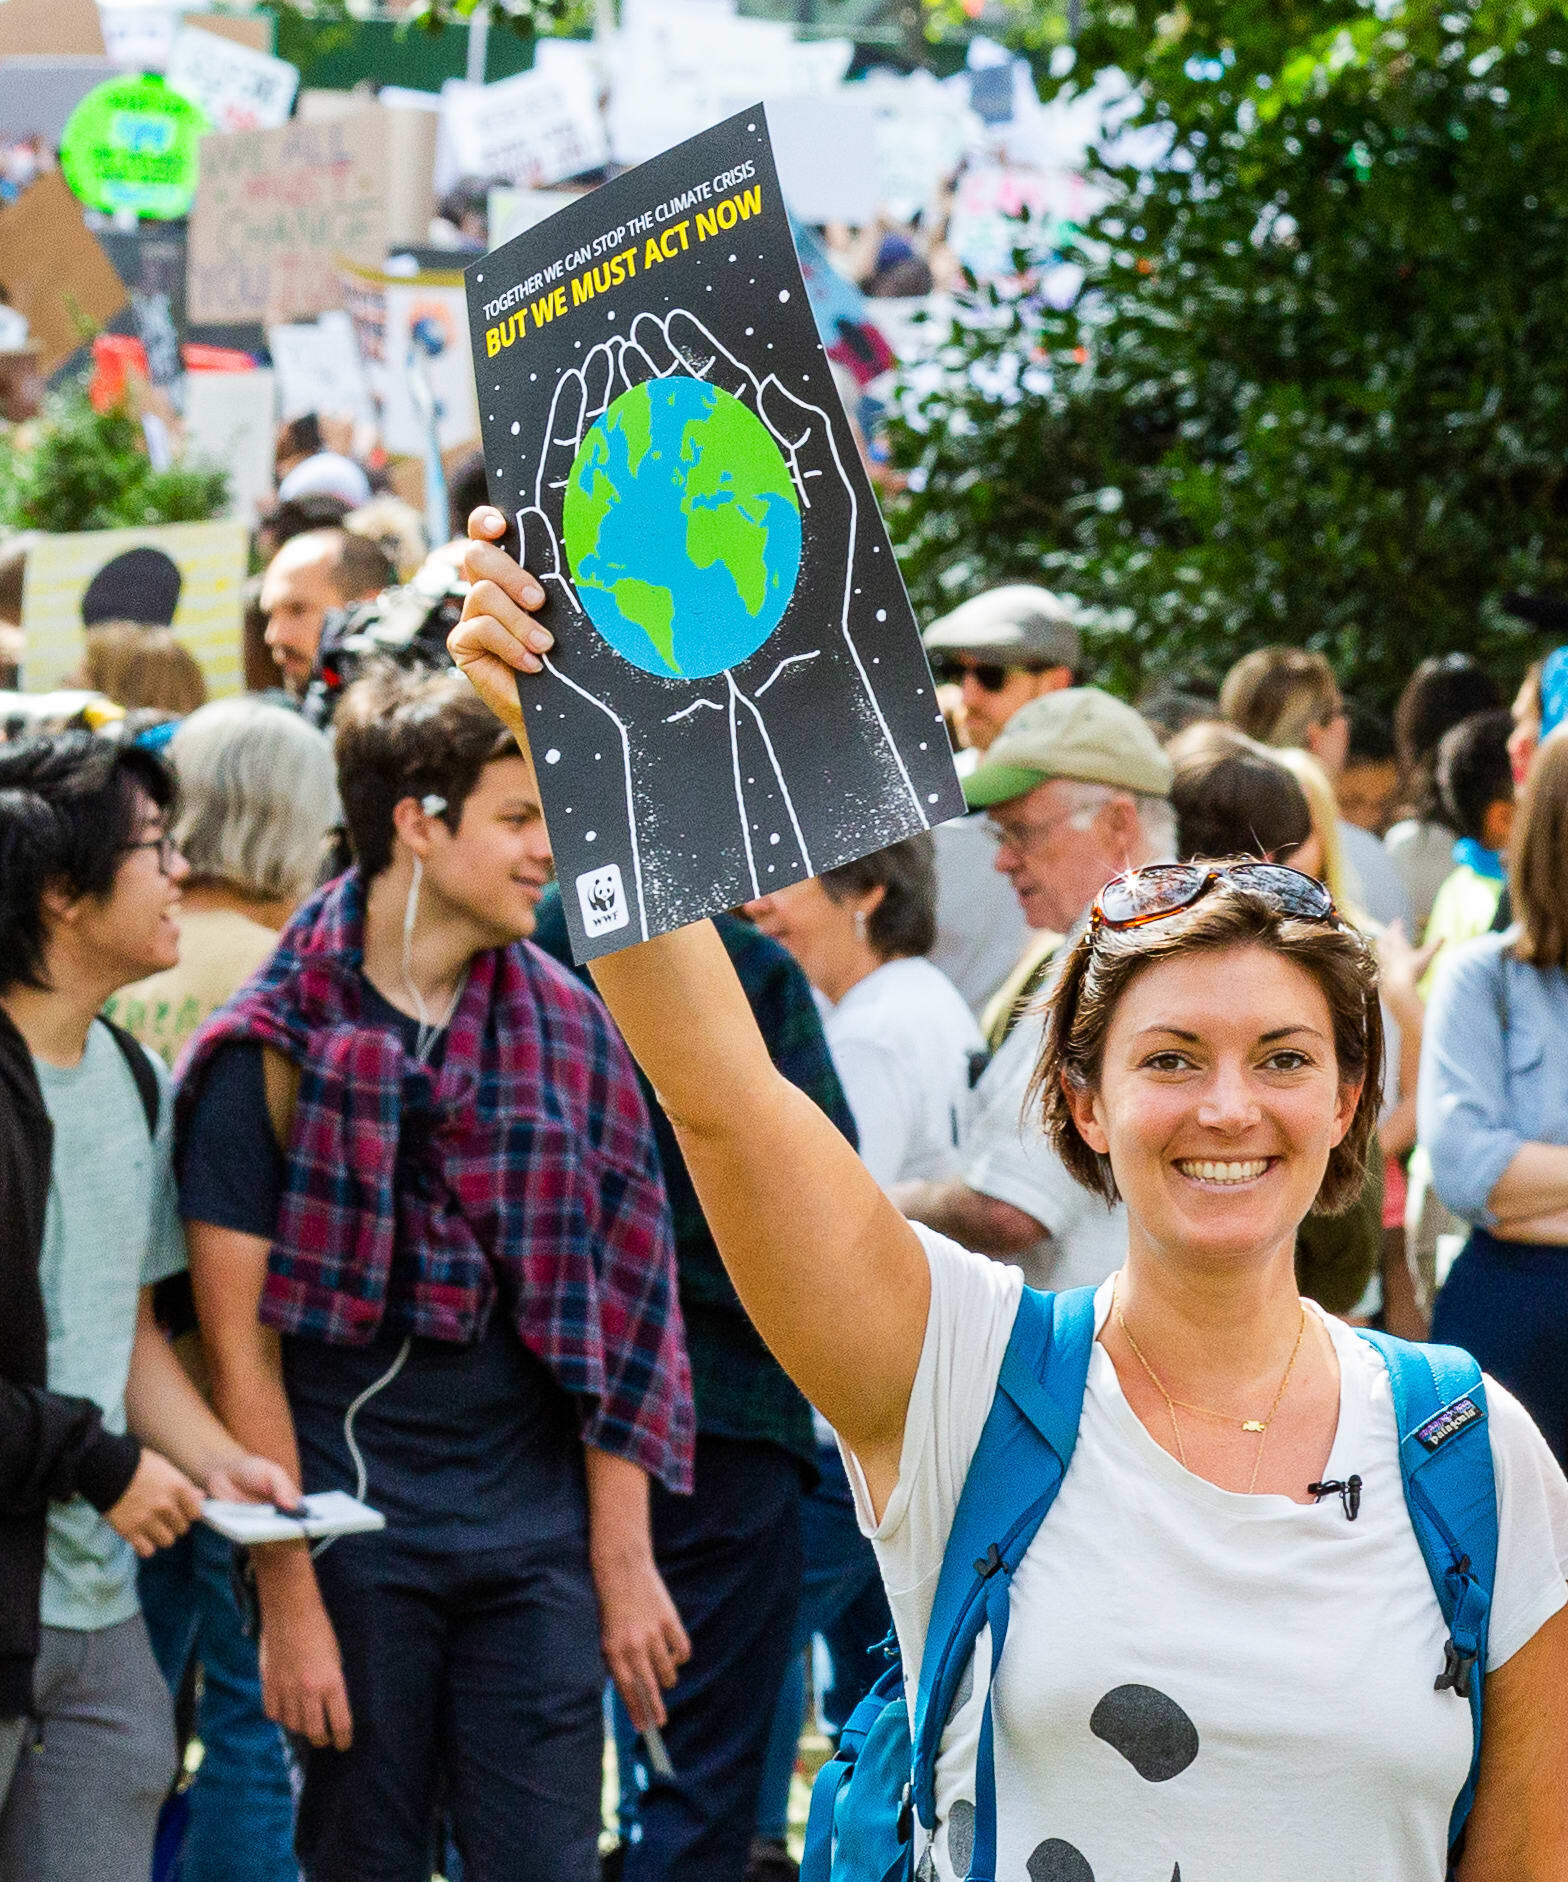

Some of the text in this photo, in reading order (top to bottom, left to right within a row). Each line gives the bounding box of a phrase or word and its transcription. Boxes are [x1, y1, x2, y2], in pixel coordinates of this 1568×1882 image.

[483, 160, 756, 320] TOGETHER WE CAN STOP THE CLIMATE CRISIS
[485, 185, 762, 358] BUT WE MUST ACT NOW
[593, 911, 618, 927] WWF
[1430, 1408, 1476, 1445] patagonia
